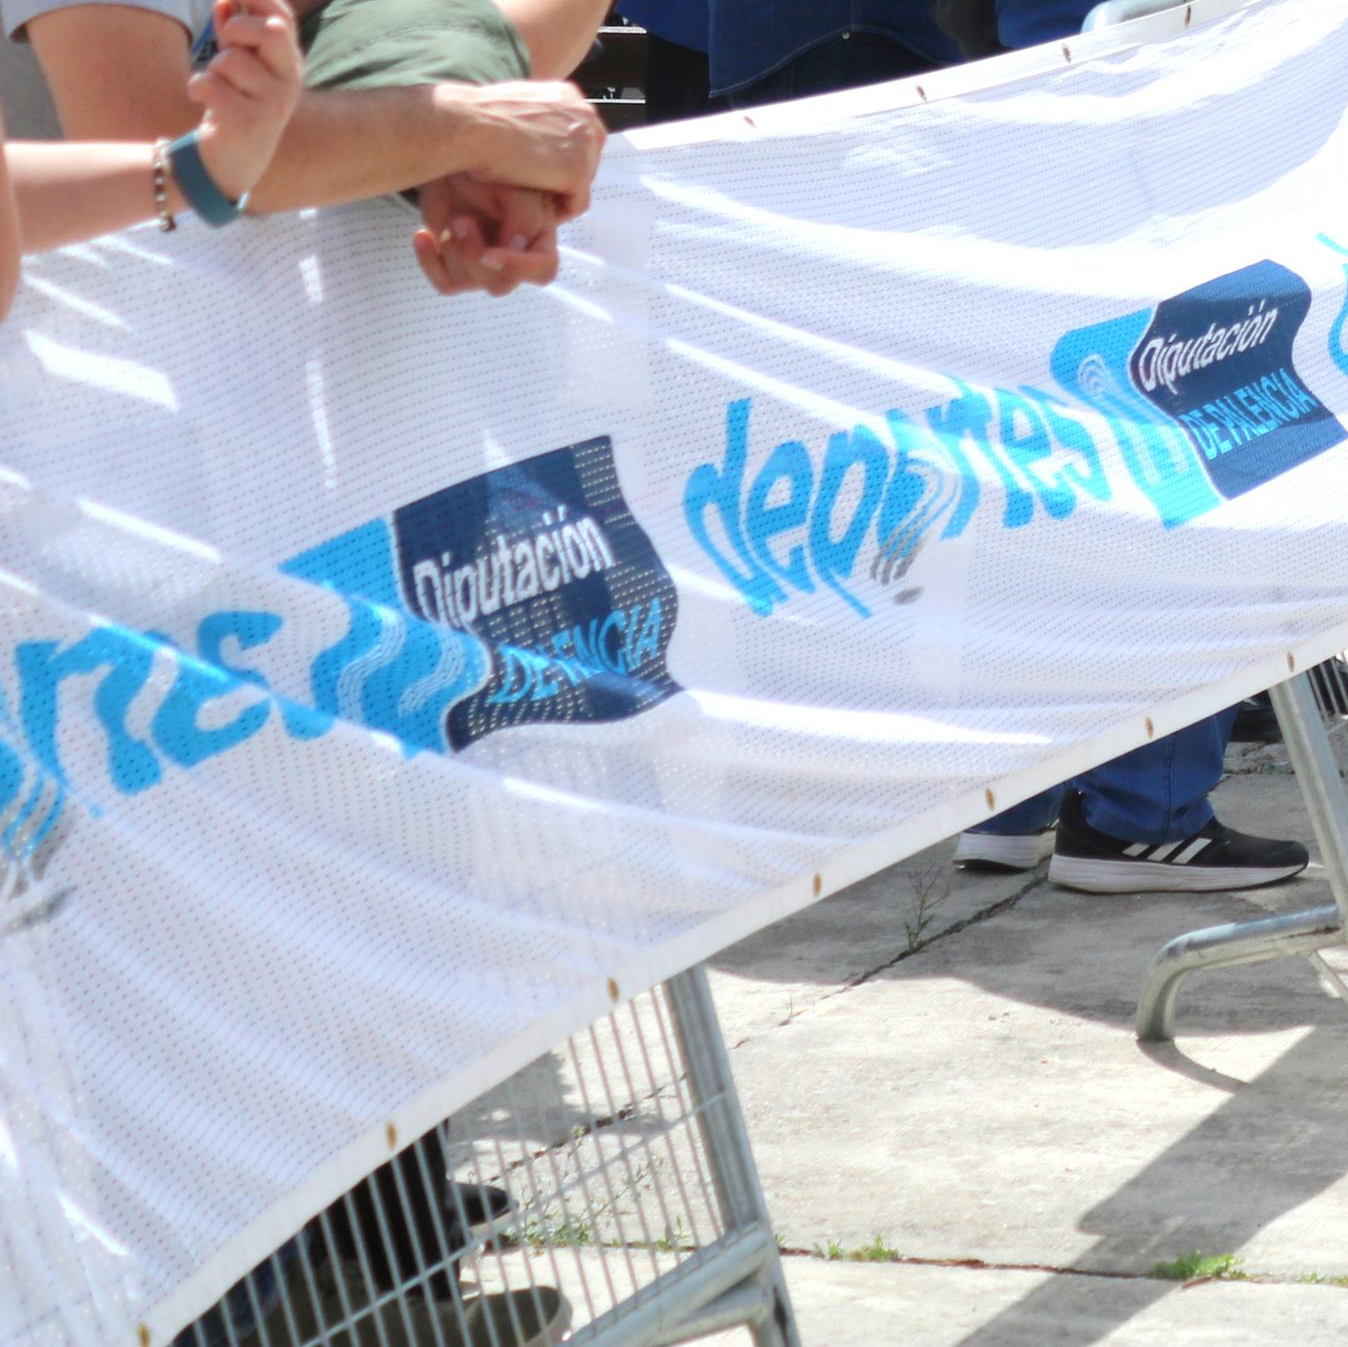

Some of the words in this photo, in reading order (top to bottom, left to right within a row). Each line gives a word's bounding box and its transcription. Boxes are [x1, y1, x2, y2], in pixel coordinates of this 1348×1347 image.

[1138, 299, 1279, 396] Diputación
[1177, 409, 1232, 461] DE
[1203, 367, 1319, 446] PALENCIA
